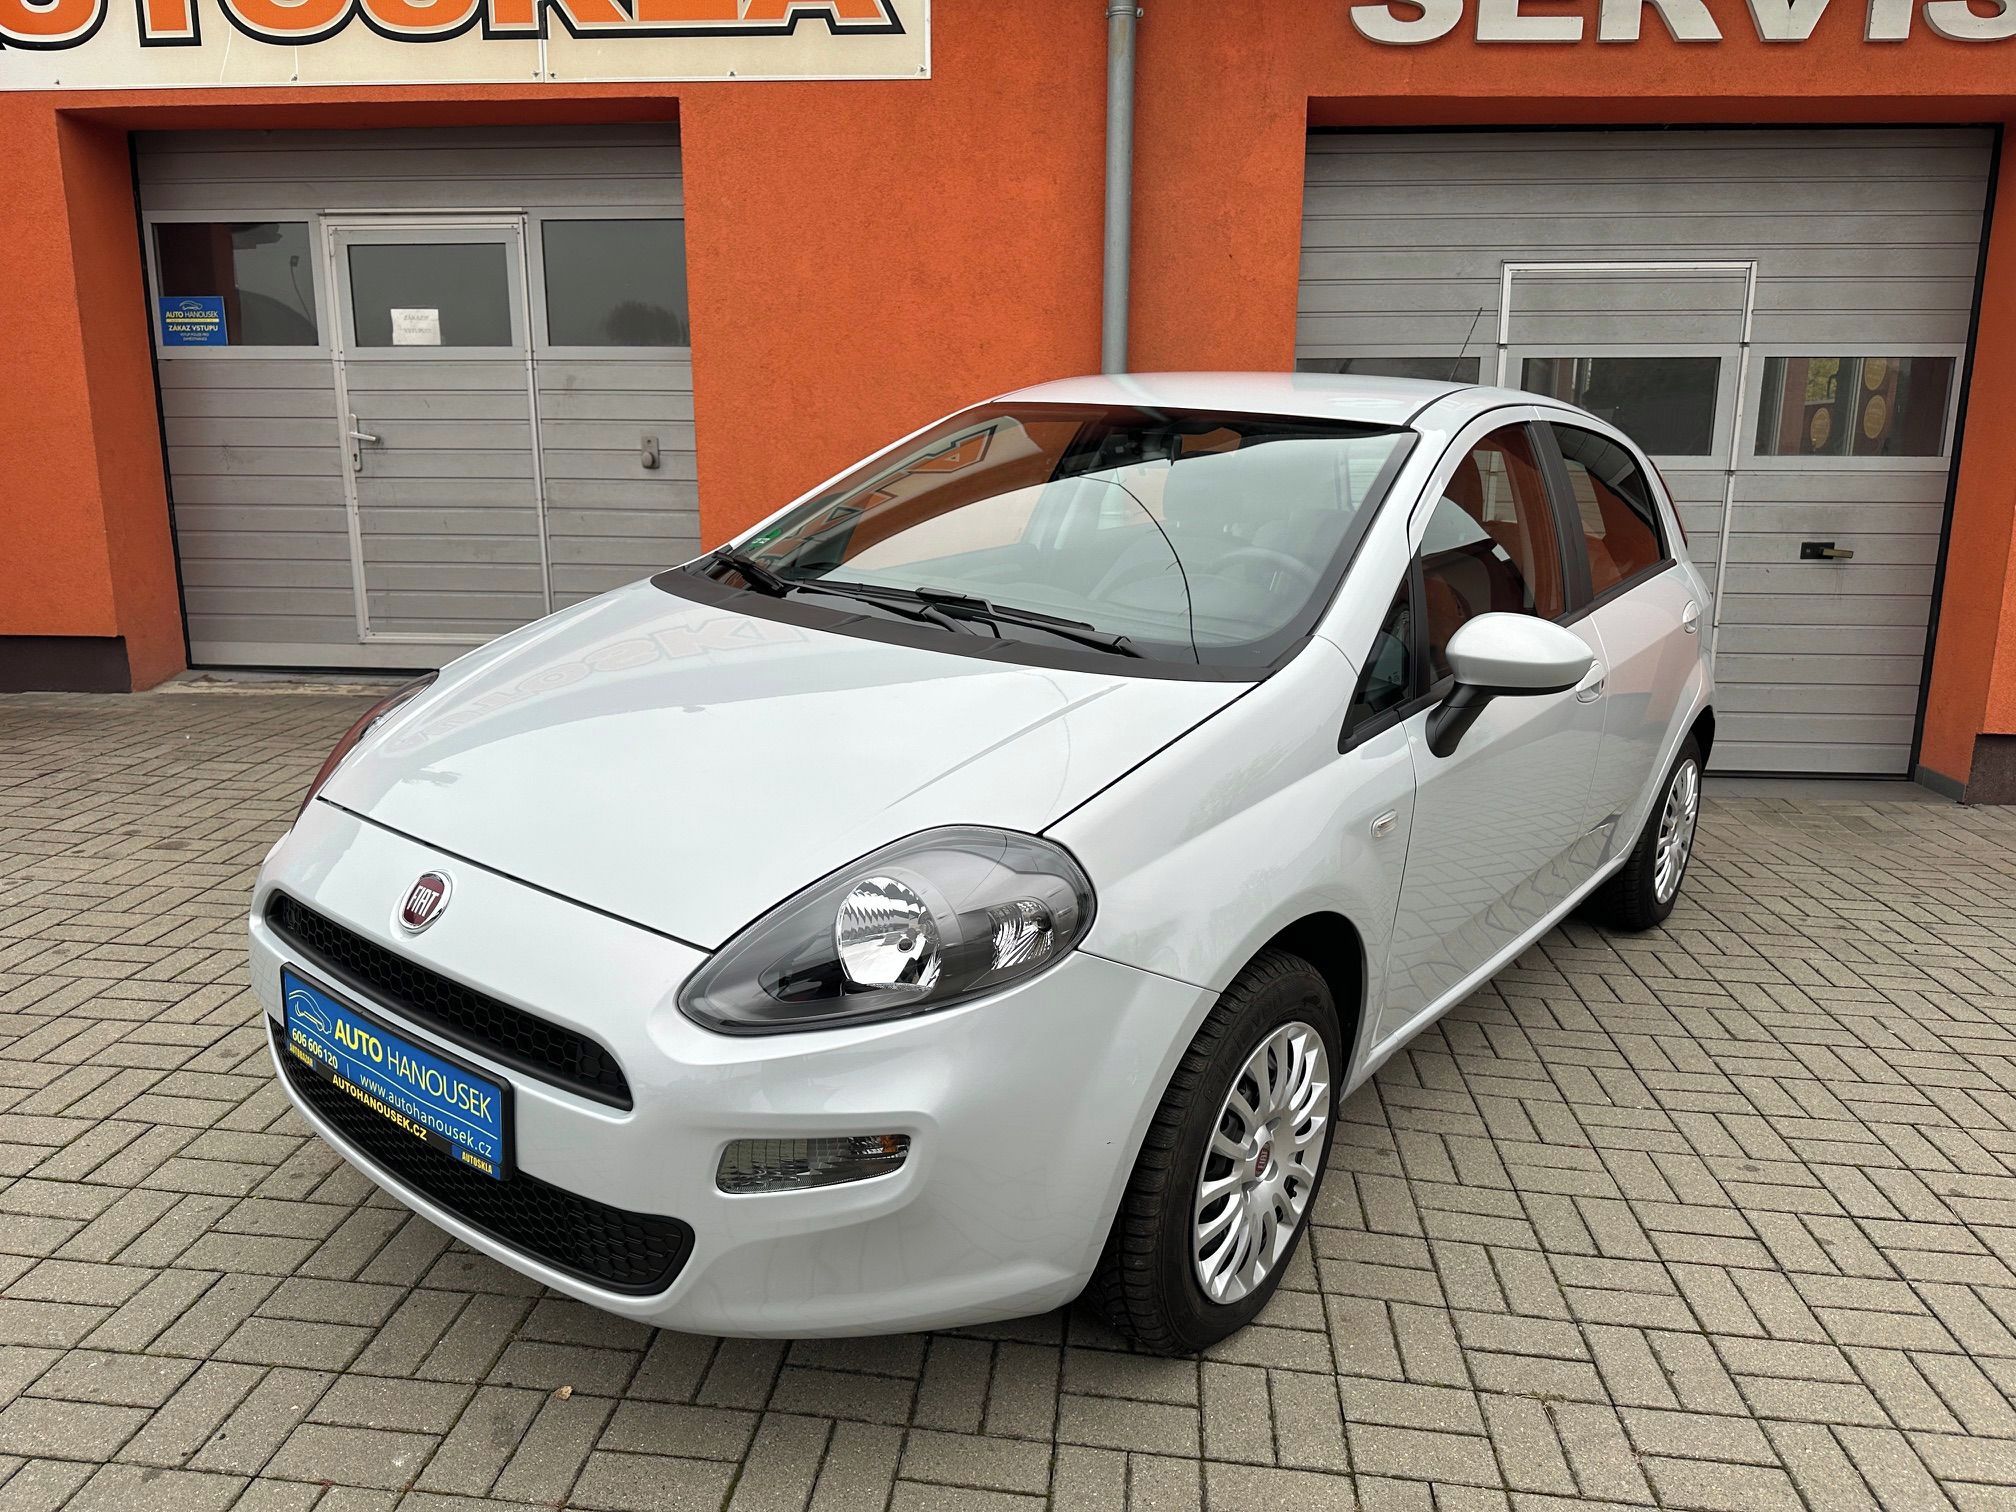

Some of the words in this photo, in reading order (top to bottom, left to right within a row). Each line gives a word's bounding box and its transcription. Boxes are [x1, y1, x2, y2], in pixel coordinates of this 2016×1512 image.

[406, 885, 440, 918] FIAT
[292, 1028, 307, 1048] 606
[307, 1038, 323, 1059] 606
[323, 1048, 338, 1070] 120
[360, 1074, 493, 1158] www.autohanousek.cz
[334, 1018, 383, 1063] AUTO
[387, 1046, 493, 1124] HANOUSEK
[461, 1151, 493, 1175] AUTOSKLA
